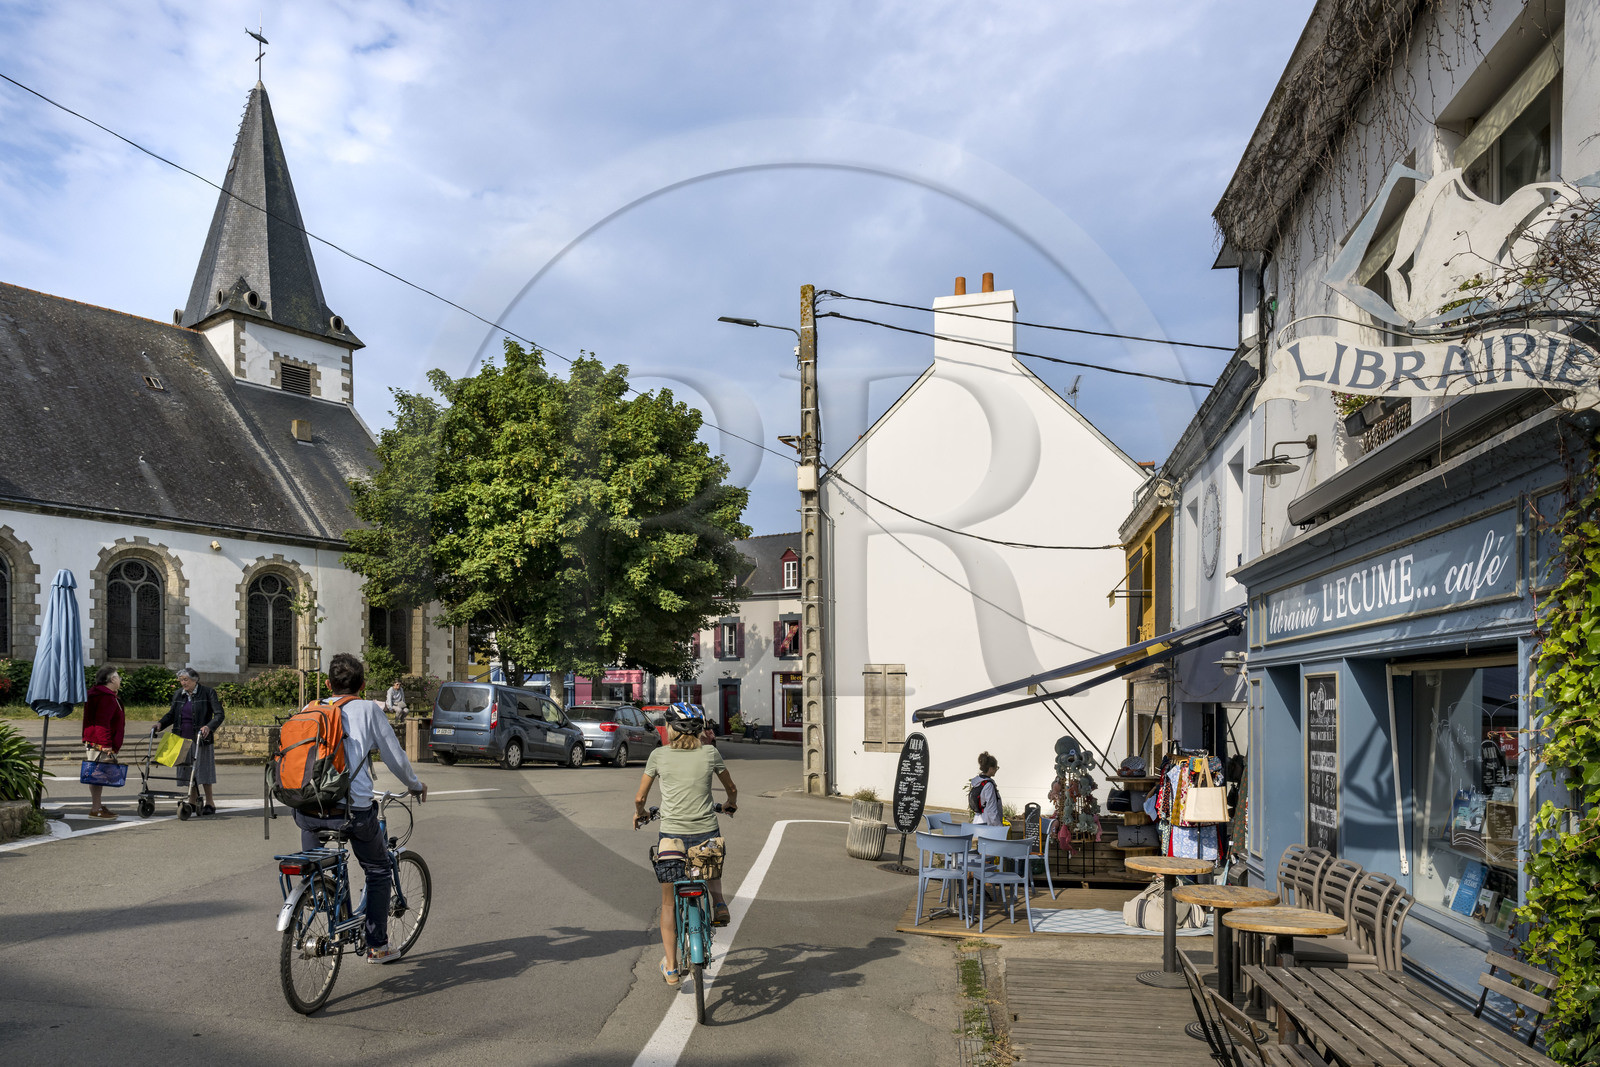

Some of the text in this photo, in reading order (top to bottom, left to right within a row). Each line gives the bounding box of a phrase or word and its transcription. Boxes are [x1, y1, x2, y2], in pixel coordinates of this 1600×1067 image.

[1286, 333, 1595, 391] LIBRAIRIE
[1269, 598, 1320, 635] librairie
[1444, 529, 1509, 601] café
